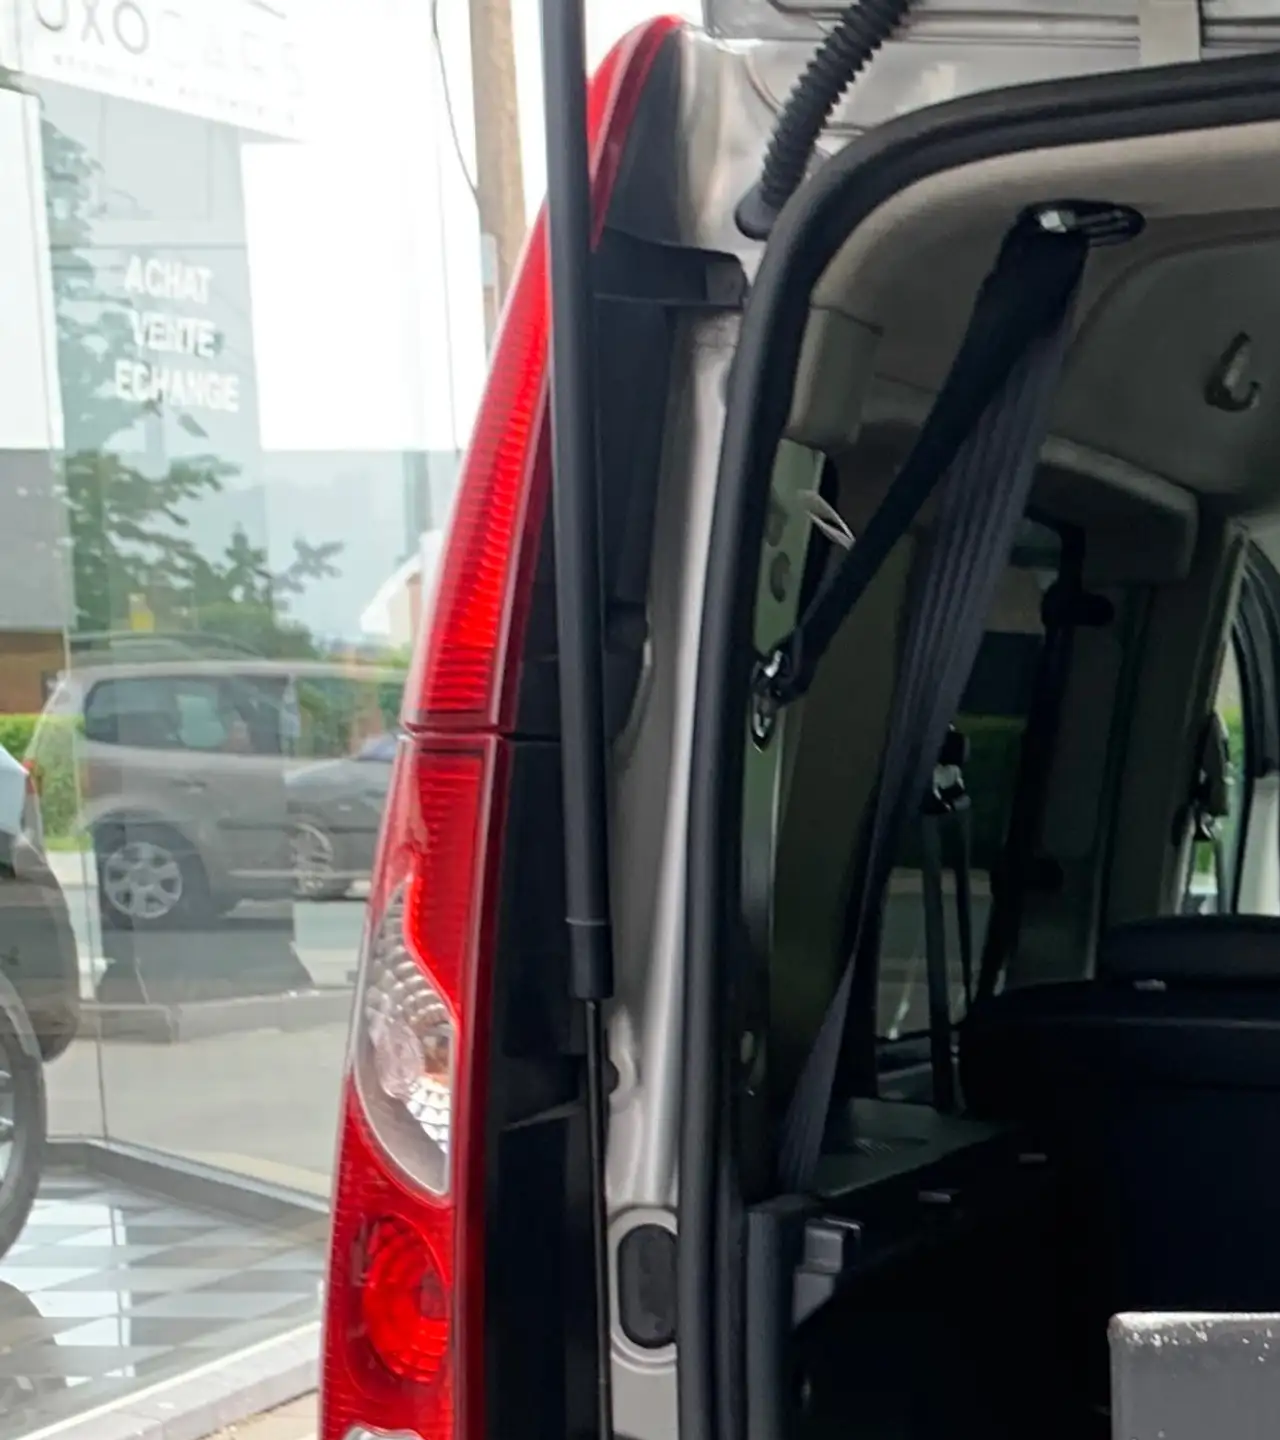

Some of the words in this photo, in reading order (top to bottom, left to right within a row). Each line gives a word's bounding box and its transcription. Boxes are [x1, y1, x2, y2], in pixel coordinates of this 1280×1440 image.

[124, 254, 214, 304] ACHAT
[128, 309, 217, 360] VENTE
[114, 359, 240, 413] ECHANGE
